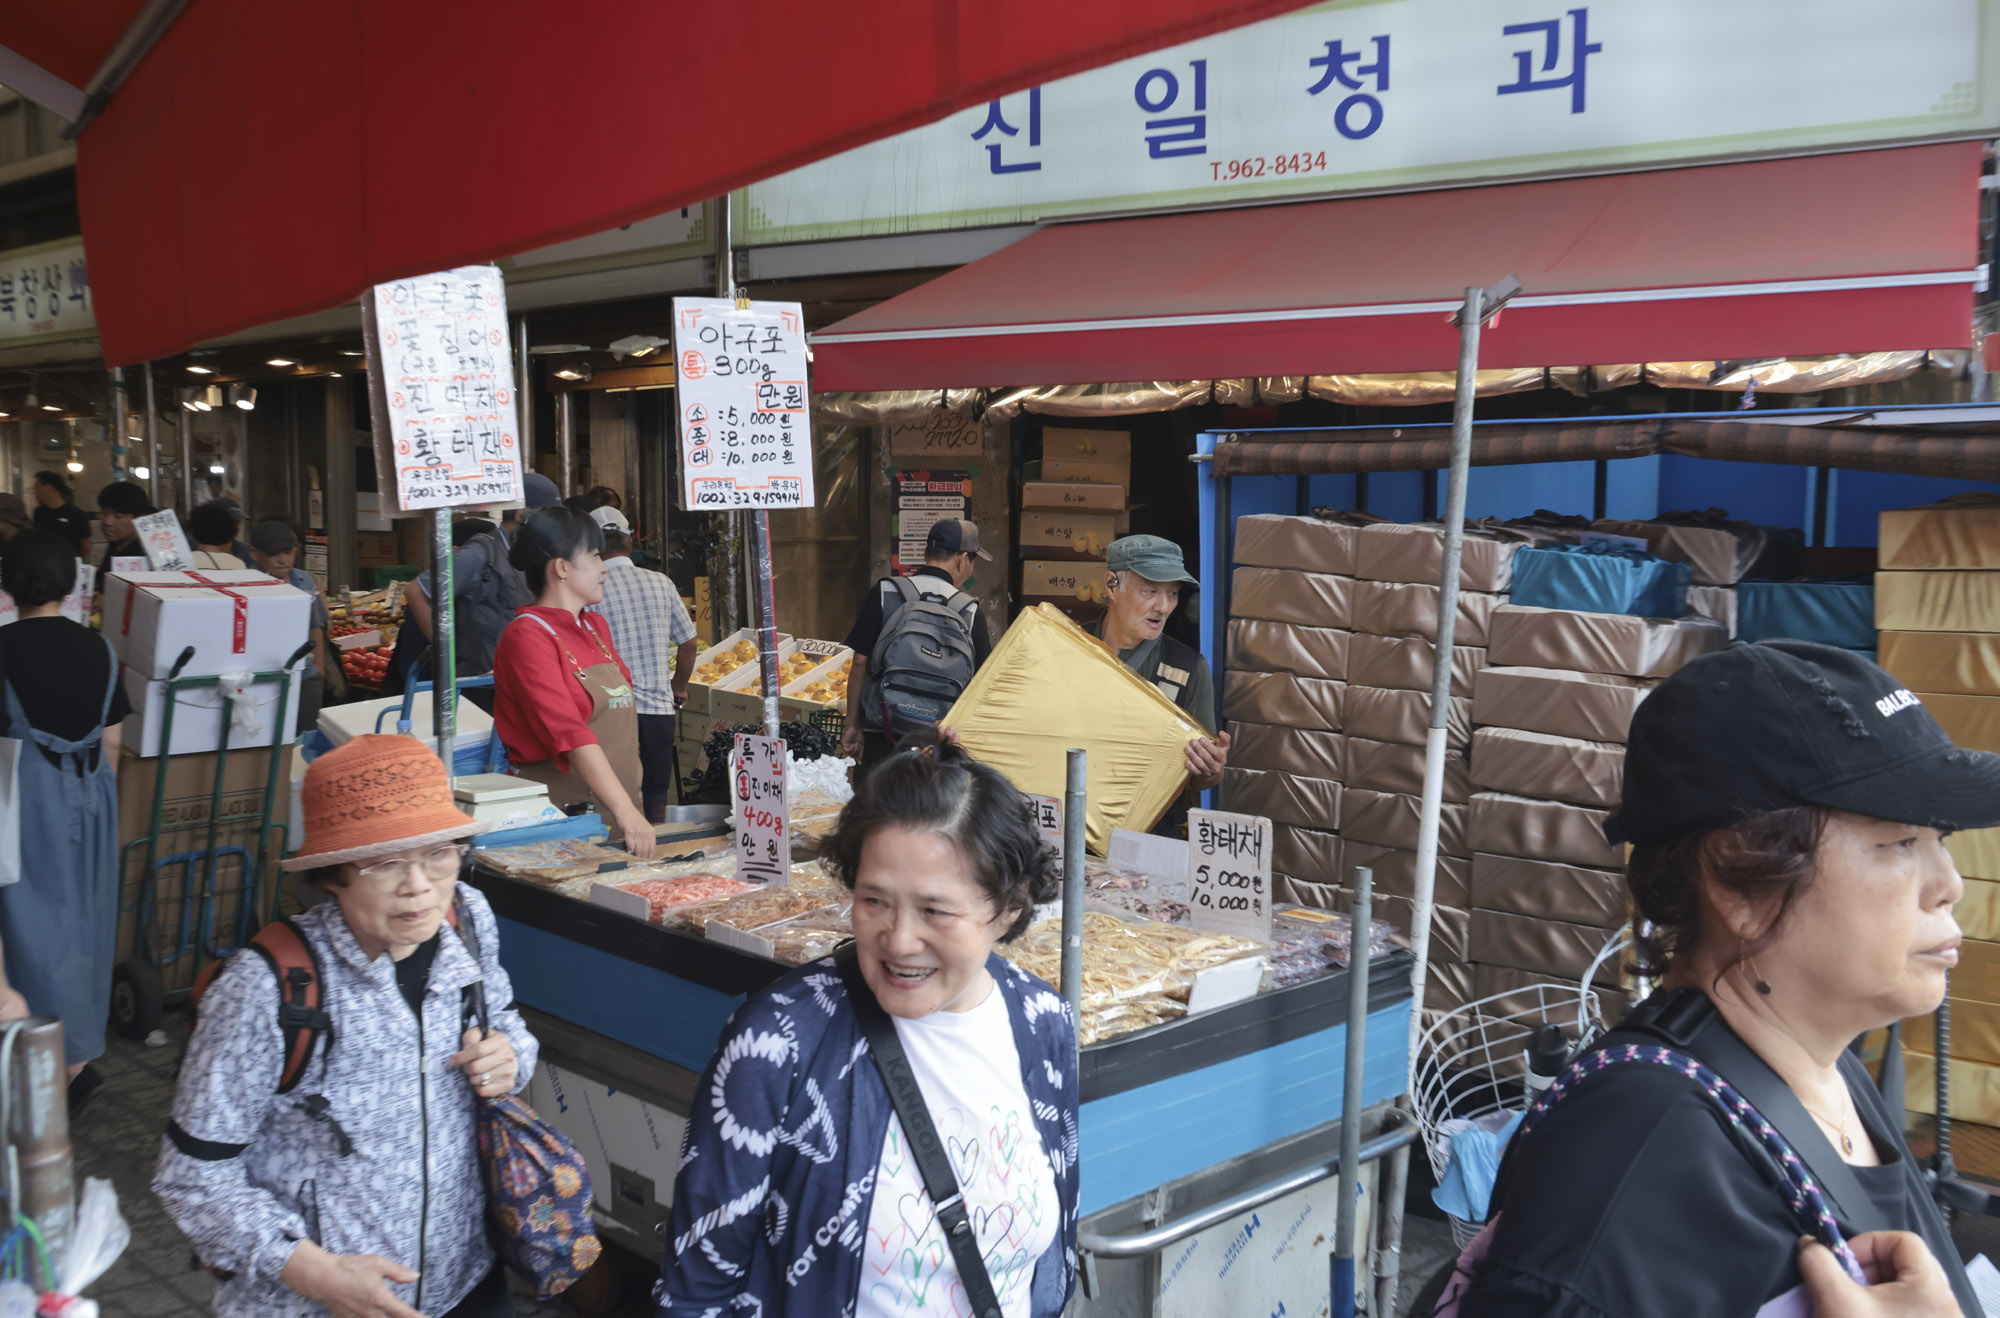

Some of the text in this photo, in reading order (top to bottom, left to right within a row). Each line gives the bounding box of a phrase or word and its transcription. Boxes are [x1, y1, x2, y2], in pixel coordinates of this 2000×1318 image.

[970, 7, 1603, 175] 신일청과
[1209, 150, 1327, 181] T.962-8434
[699, 322, 787, 354] 아구포
[713, 355, 776, 382] 300g
[759, 384, 803, 409] 만원
[690, 406, 705, 423] 소
[413, 421, 505, 467] 황태채
[691, 427, 707, 446] 중
[693, 449, 709, 465] 대
[1197, 818, 1263, 870] 황태채
[785, 1243, 818, 1287] for
